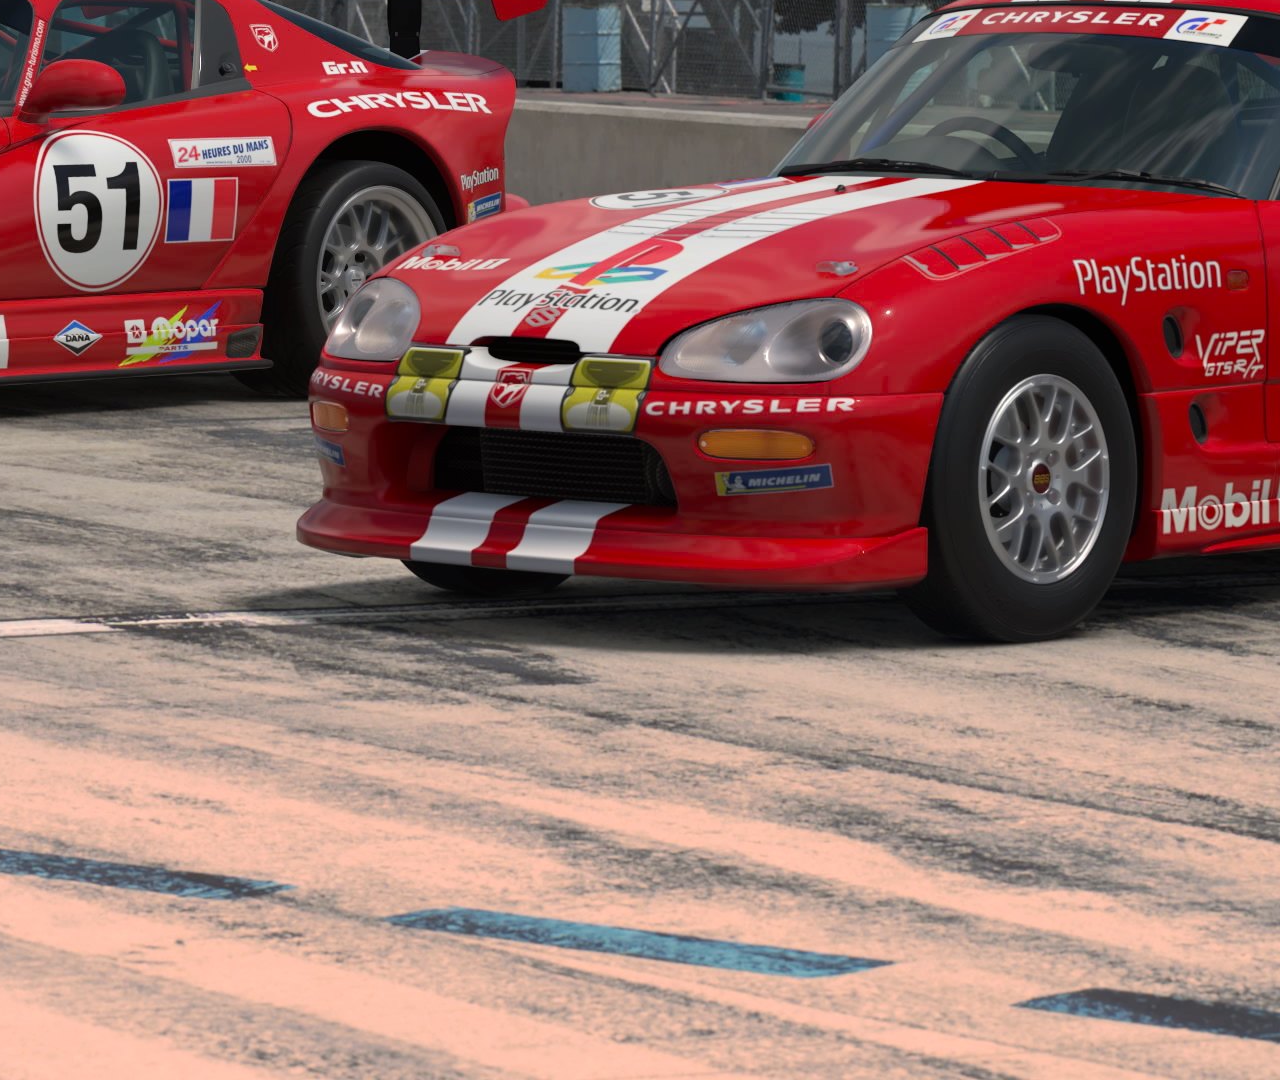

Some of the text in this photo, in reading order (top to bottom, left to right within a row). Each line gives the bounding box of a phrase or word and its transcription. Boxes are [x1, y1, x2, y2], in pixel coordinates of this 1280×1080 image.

[982, 10, 1165, 27] CHRYSLER
[307, 91, 493, 118] CHRYSLER
[177, 139, 269, 163] 24 HEURES DU MANS
[236, 154, 252, 164] 2000
[461, 166, 499, 192] PlayStation
[53, 162, 141, 253] 51
[395, 256, 477, 270] Mobil
[1073, 254, 1222, 306] PlayStation
[477, 290, 640, 312] PlayStation
[65, 333, 91, 343] DANA
[151, 316, 219, 342] Mopar
[645, 397, 855, 416] CHRYSLER
[748, 473, 821, 487] MICHELIN
[1160, 479, 1272, 535] Mobil
